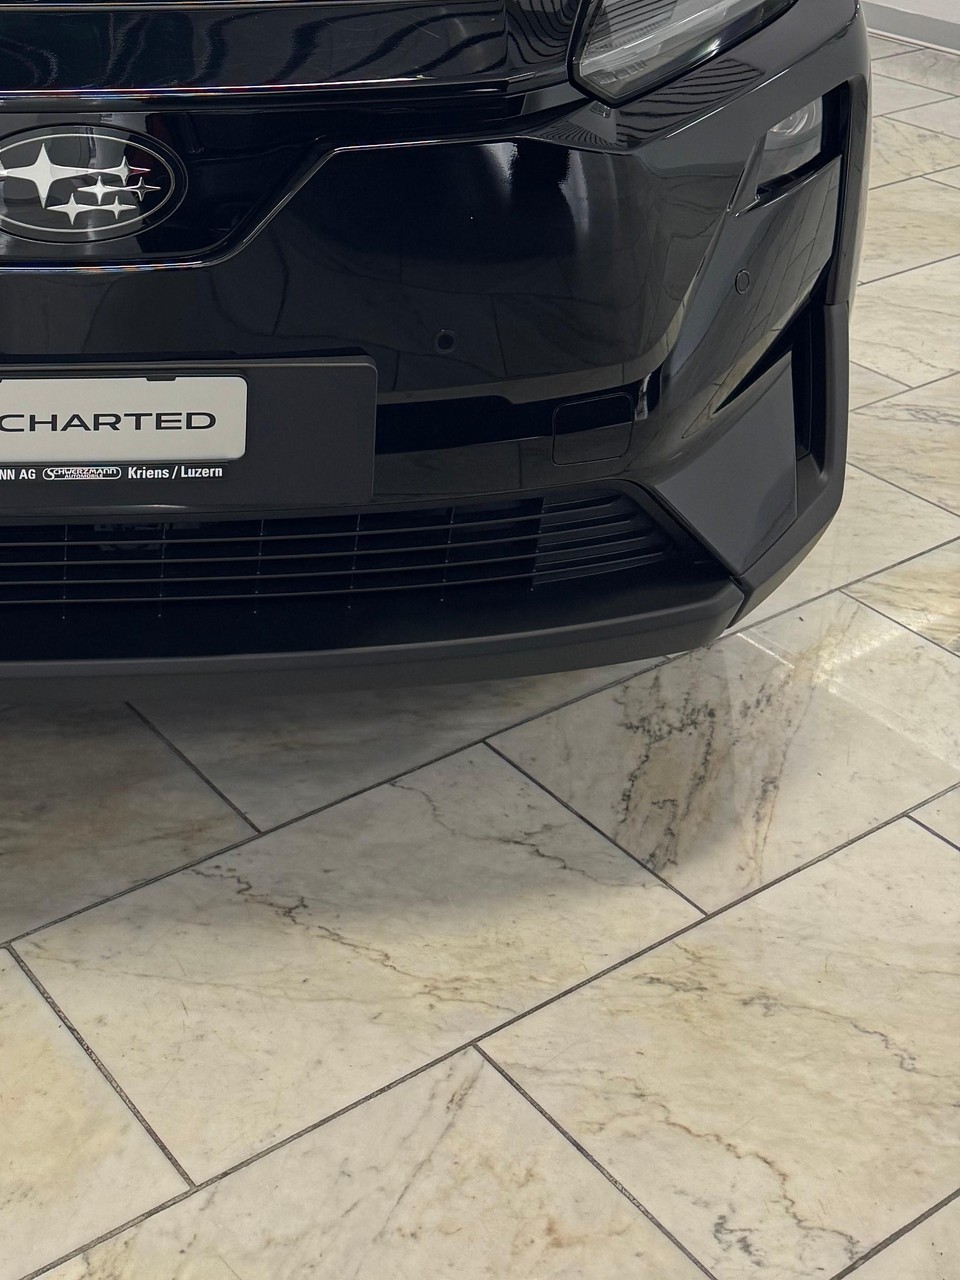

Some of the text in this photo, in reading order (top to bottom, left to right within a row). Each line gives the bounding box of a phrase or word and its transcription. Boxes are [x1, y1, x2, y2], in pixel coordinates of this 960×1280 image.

[19, 468, 36, 480] AG
[128, 466, 170, 479] Kriens
[181, 465, 223, 478] Luzern
